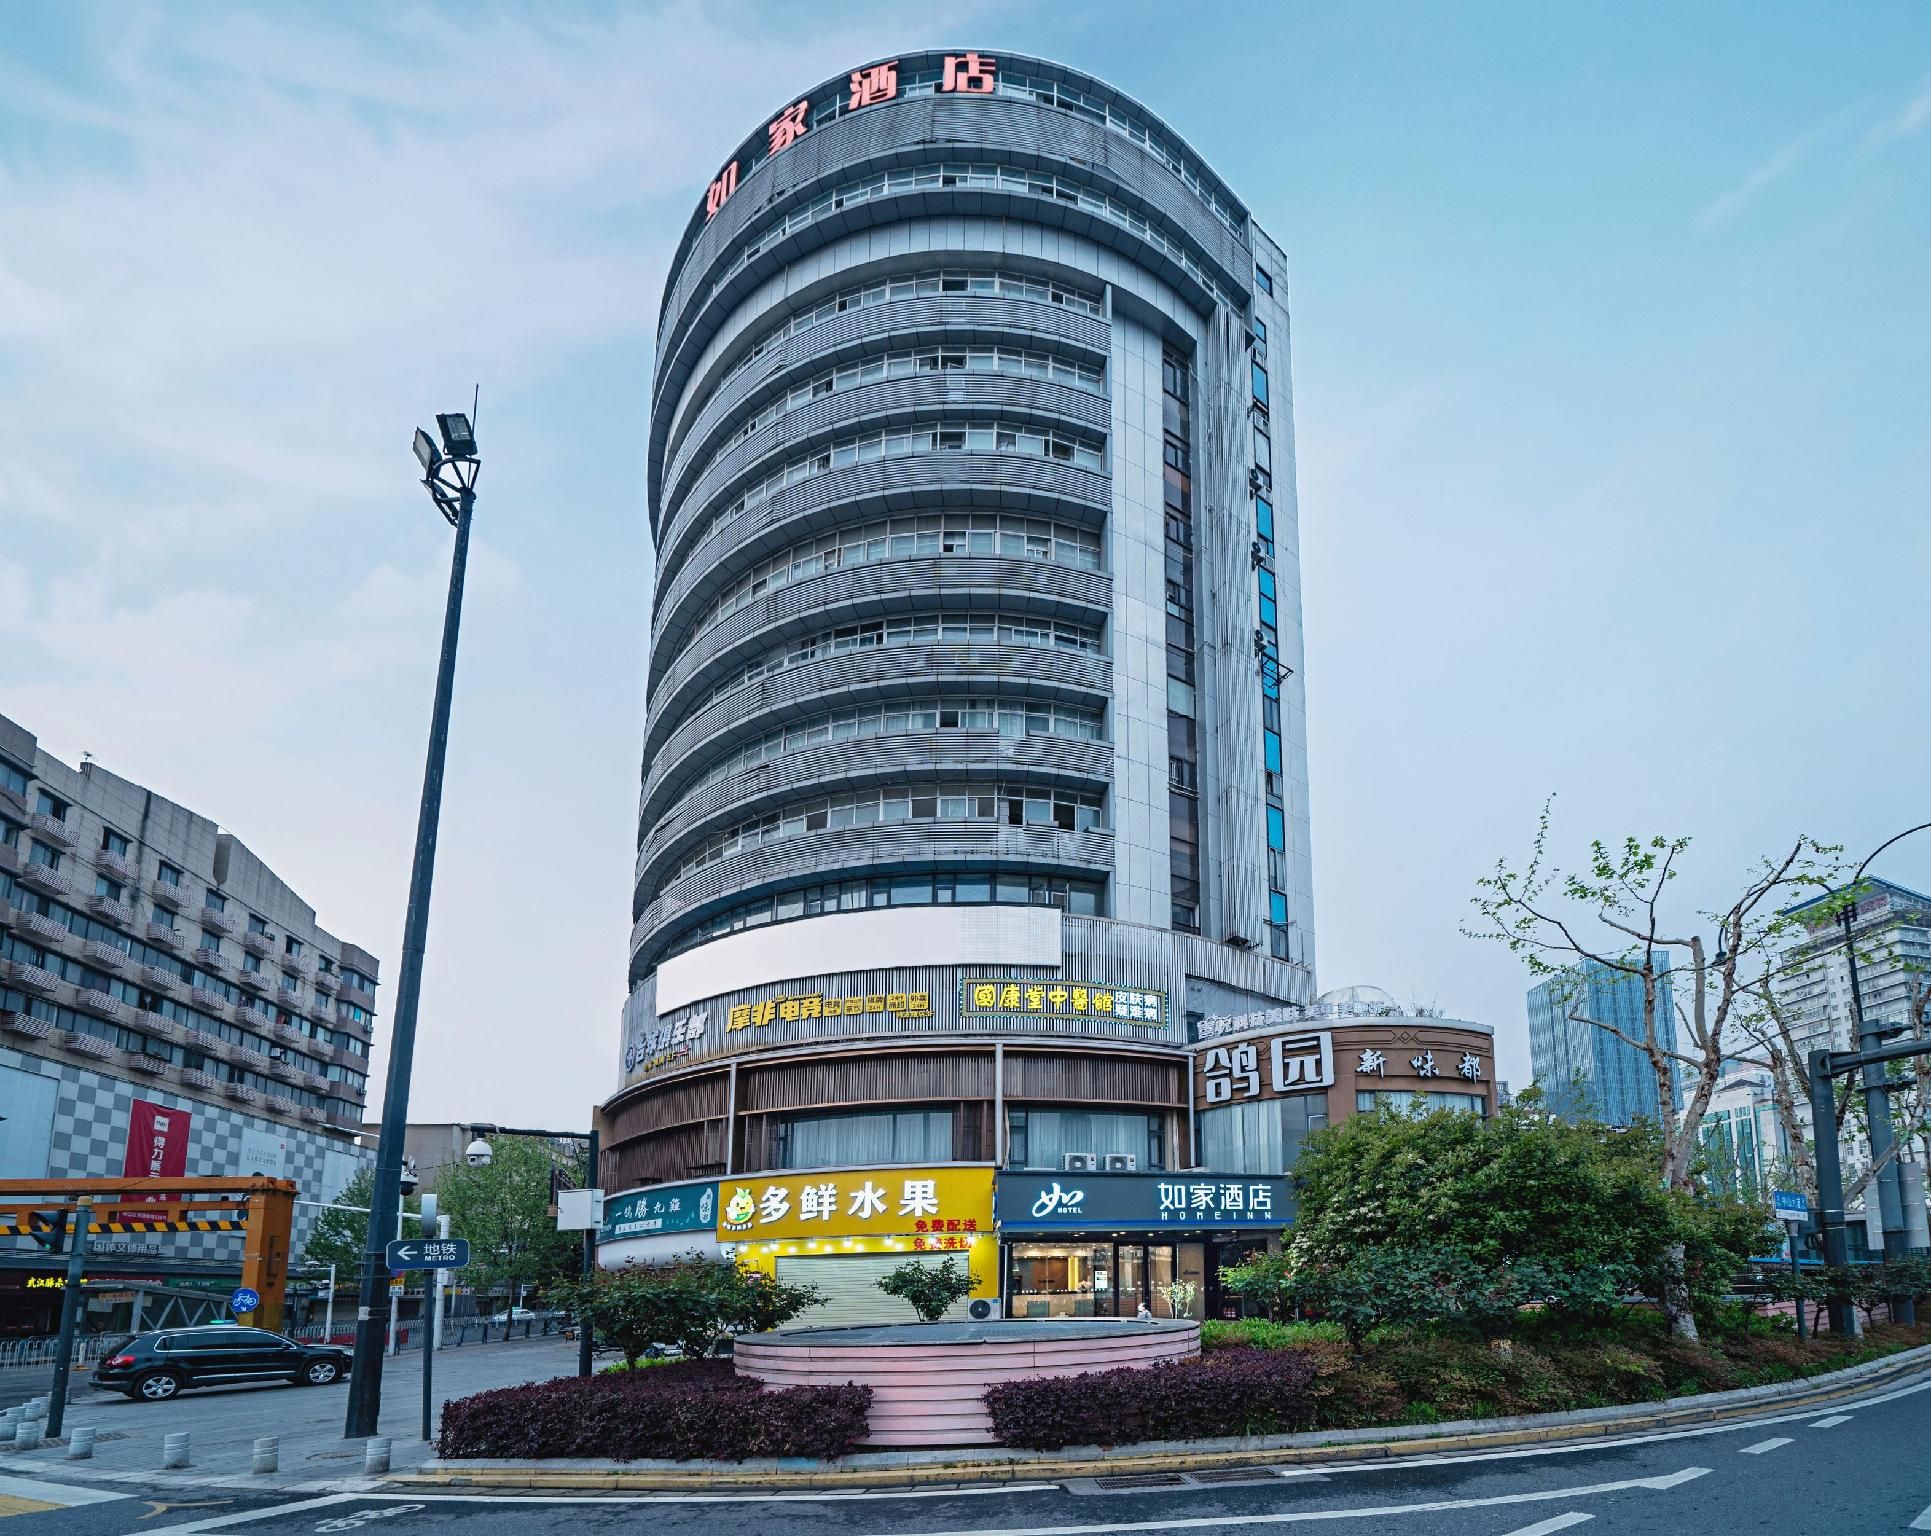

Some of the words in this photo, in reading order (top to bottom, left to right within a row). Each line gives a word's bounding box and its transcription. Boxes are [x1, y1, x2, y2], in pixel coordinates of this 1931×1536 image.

[706, 52, 996, 218] 如家酒店
[974, 984, 1115, 1012] 國康堂中醫館
[726, 997, 822, 1033] 摩非电竞
[1203, 1031, 1335, 1103] 鸽园
[1356, 1048, 1482, 1084] 新味都
[759, 1179, 940, 1224] 多鲜水果
[1158, 1182, 1272, 1211] 如家酒店
[914, 1219, 978, 1233] 免费配送
[423, 1243, 457, 1255] 地铁
[424, 1254, 456, 1262] METRO
